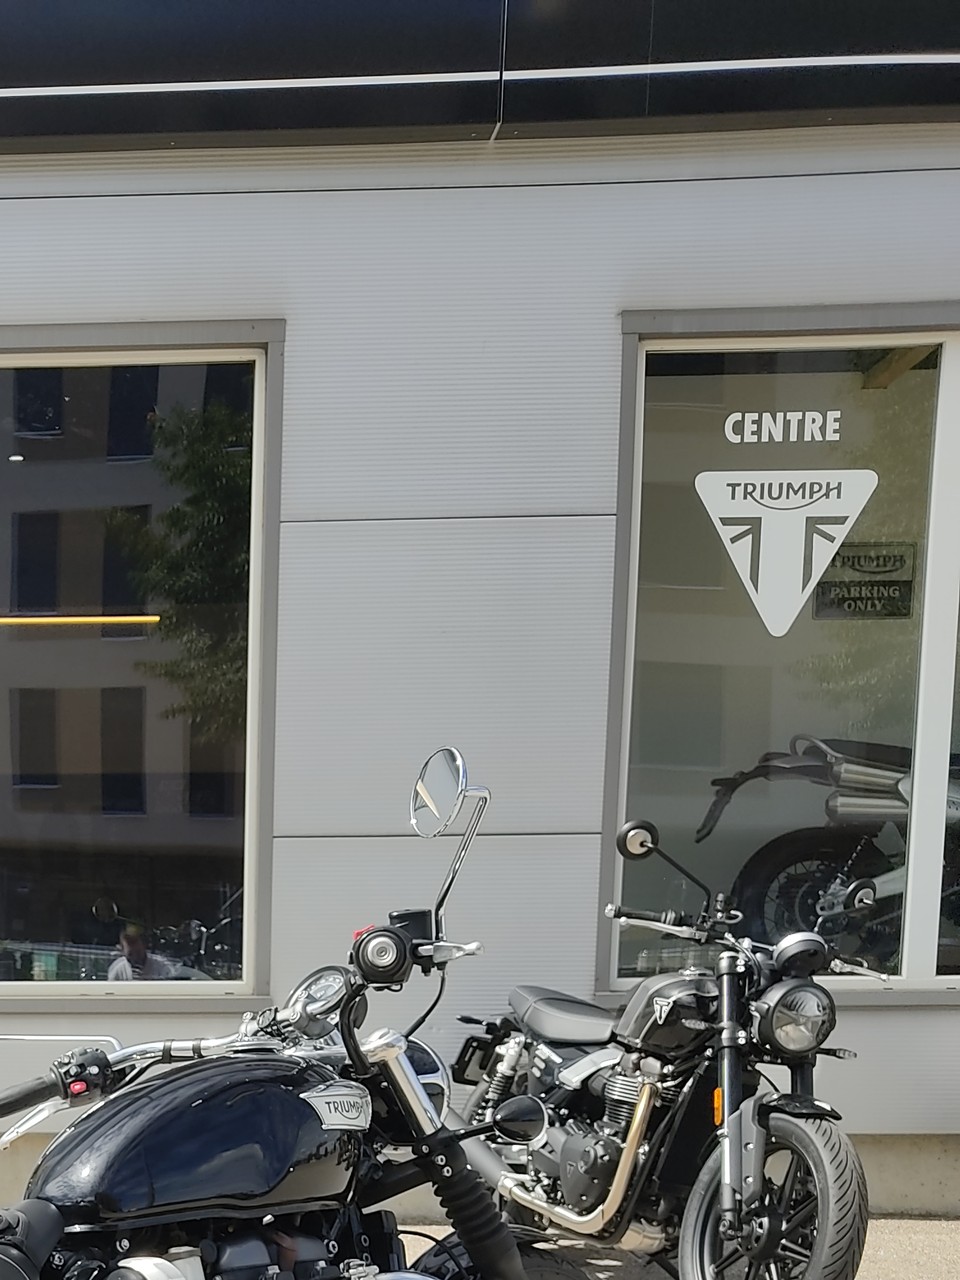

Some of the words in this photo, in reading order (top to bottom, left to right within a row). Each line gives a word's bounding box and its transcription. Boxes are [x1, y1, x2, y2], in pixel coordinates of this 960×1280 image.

[724, 410, 841, 443] CENTRE
[726, 481, 842, 509] TRIUMPH
[830, 586, 900, 598] PARKING
[843, 600, 885, 611] ONLY
